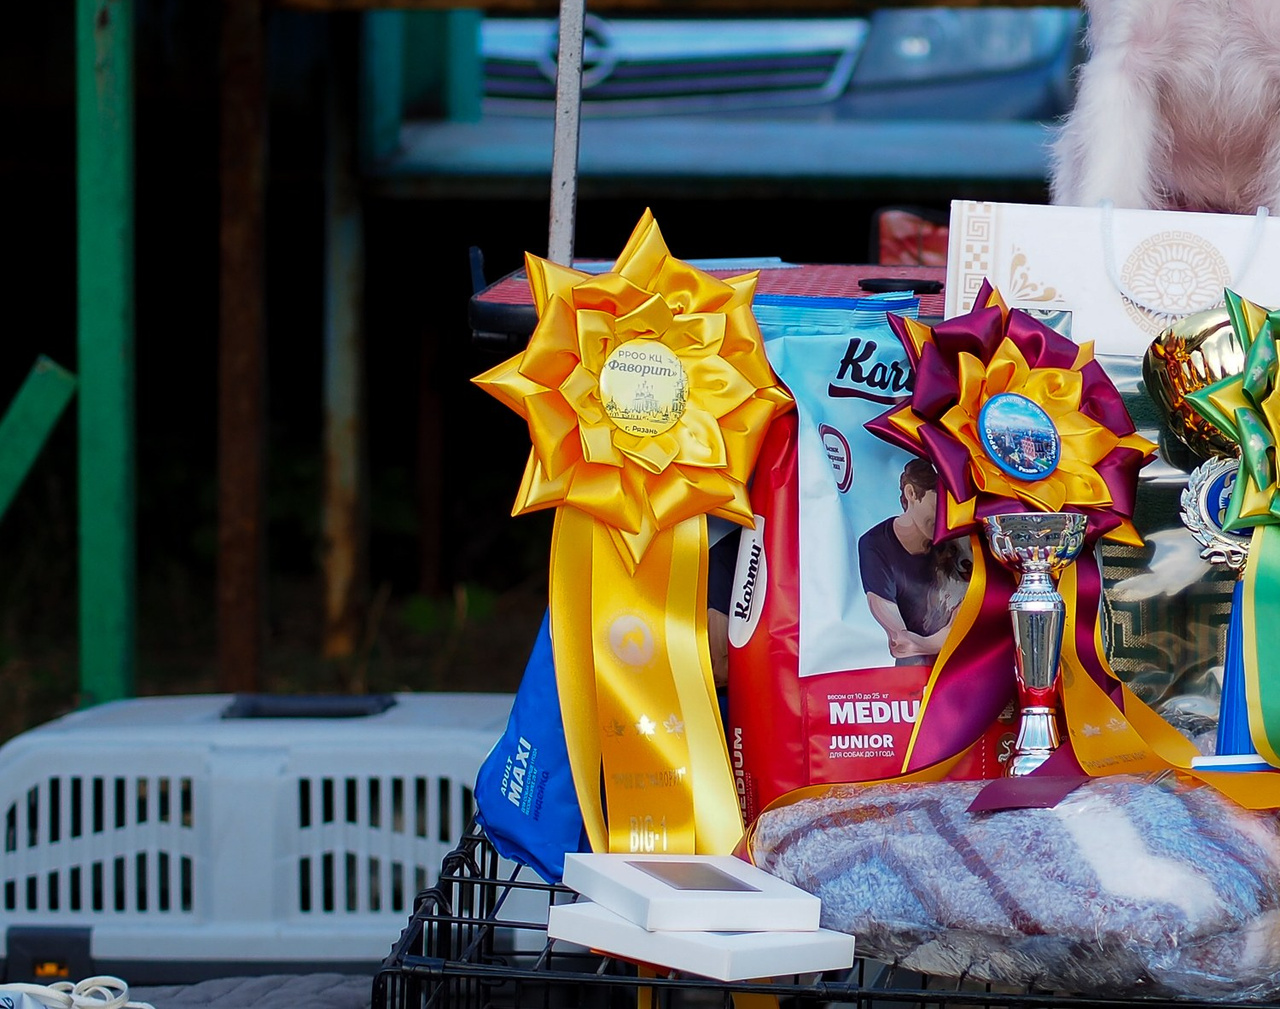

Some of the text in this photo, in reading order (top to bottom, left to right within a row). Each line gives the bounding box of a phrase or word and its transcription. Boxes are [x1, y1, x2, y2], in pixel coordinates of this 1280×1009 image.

[618, 350, 662, 364] РРОО КЦ
[829, 734, 894, 750] JUNIOR
[879, 750, 895, 758] ГОДА
[500, 755, 513, 797] ADULT
[507, 736, 532, 808] MAXI
[629, 815, 669, 853] BIG-1
